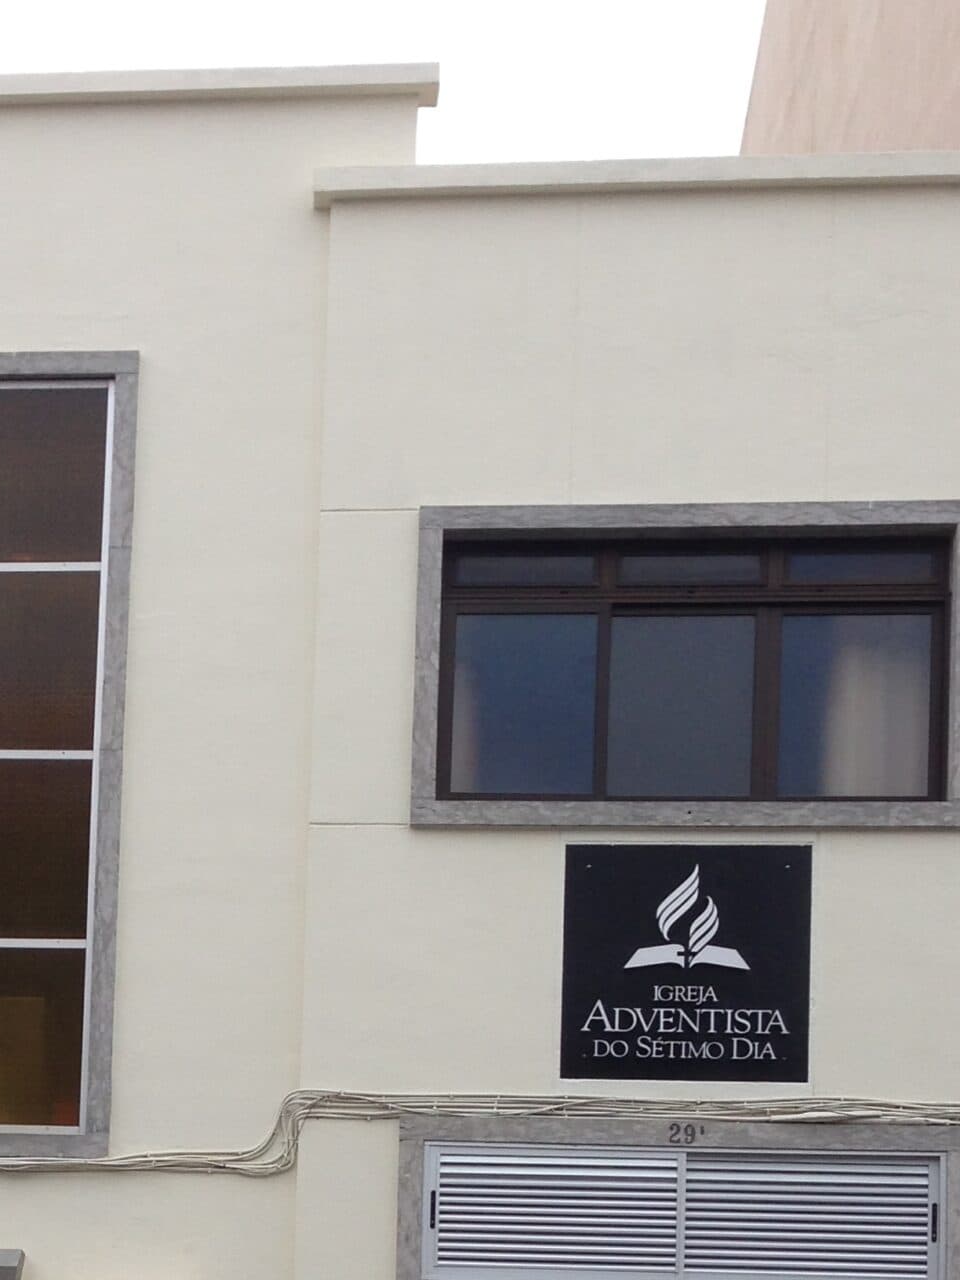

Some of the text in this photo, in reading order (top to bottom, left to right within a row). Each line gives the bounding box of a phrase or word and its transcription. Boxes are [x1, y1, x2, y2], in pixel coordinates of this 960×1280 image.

[653, 985, 719, 1005] IGREJA
[581, 999, 790, 1034] ADVENTISTA
[593, 1035, 777, 1060] DO SÉTIMO DIA
